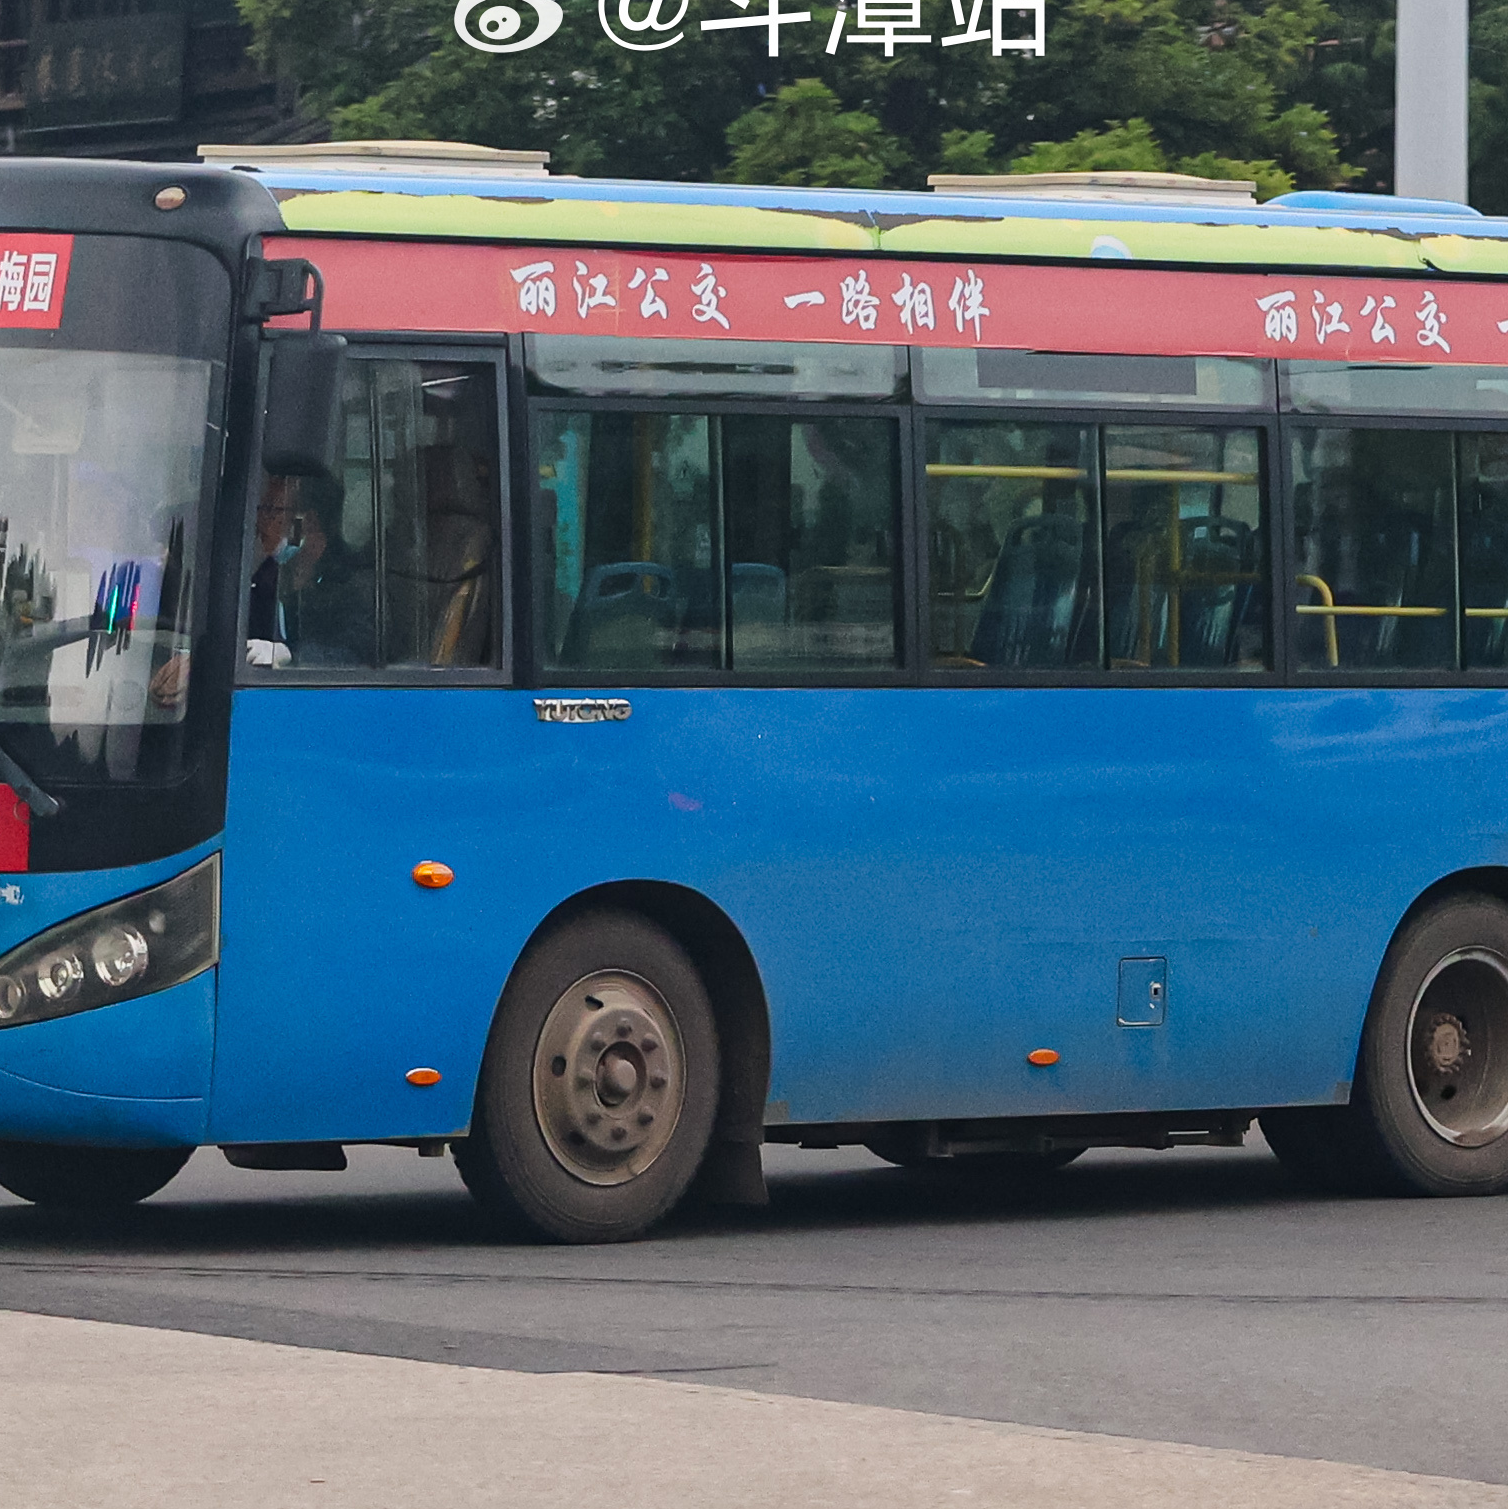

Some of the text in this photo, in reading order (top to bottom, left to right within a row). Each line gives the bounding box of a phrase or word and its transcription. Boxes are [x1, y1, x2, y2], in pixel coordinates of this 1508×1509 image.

[509, 260, 991, 341] 丽江公交 一路相伴
[1255, 289, 1451, 354] 丽江公交
[533, 698, 632, 723] YUTONG
